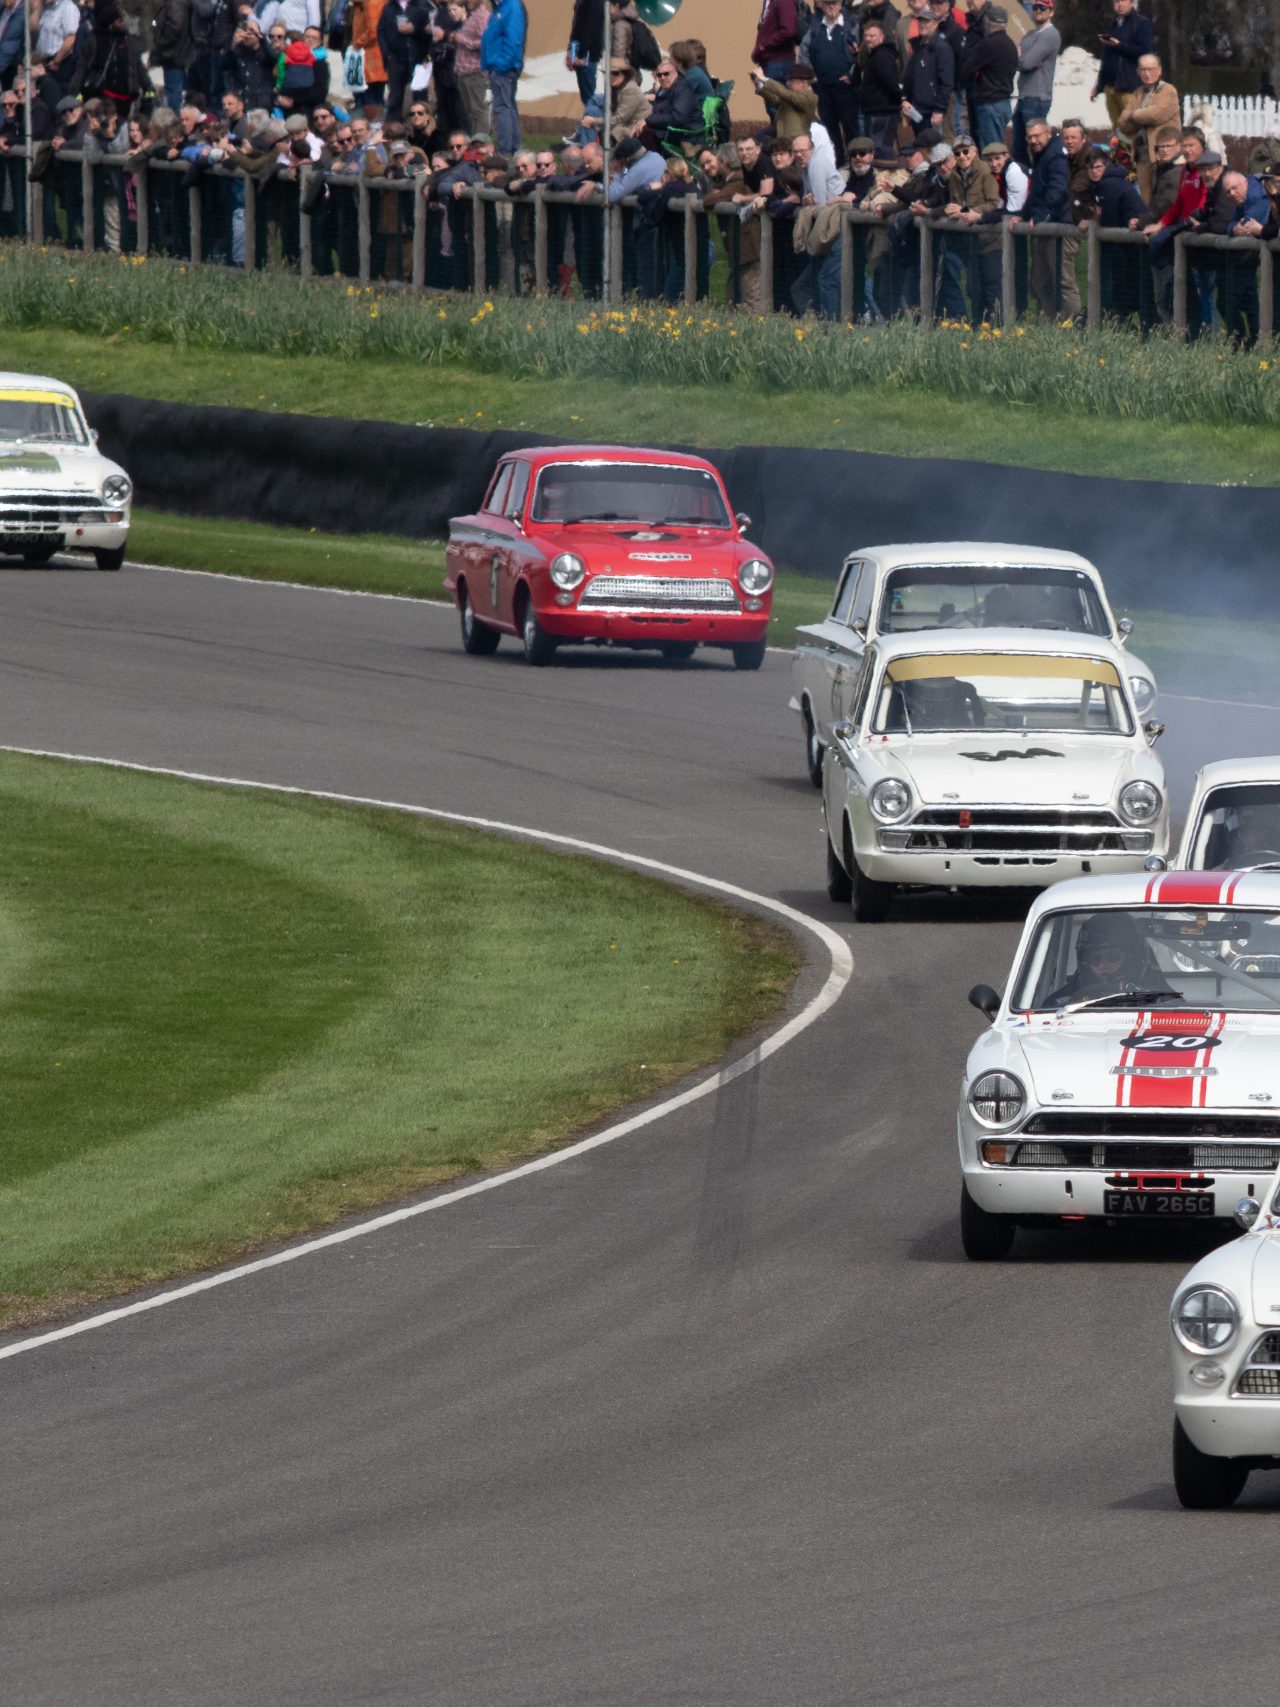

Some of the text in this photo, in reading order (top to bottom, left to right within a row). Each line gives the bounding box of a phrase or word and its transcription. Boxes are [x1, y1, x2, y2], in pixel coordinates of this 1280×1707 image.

[1136, 1036, 1207, 1048] 20
[1122, 1068, 1206, 1076] CORTINA
[1108, 1194, 1211, 1213] FAV 265C
